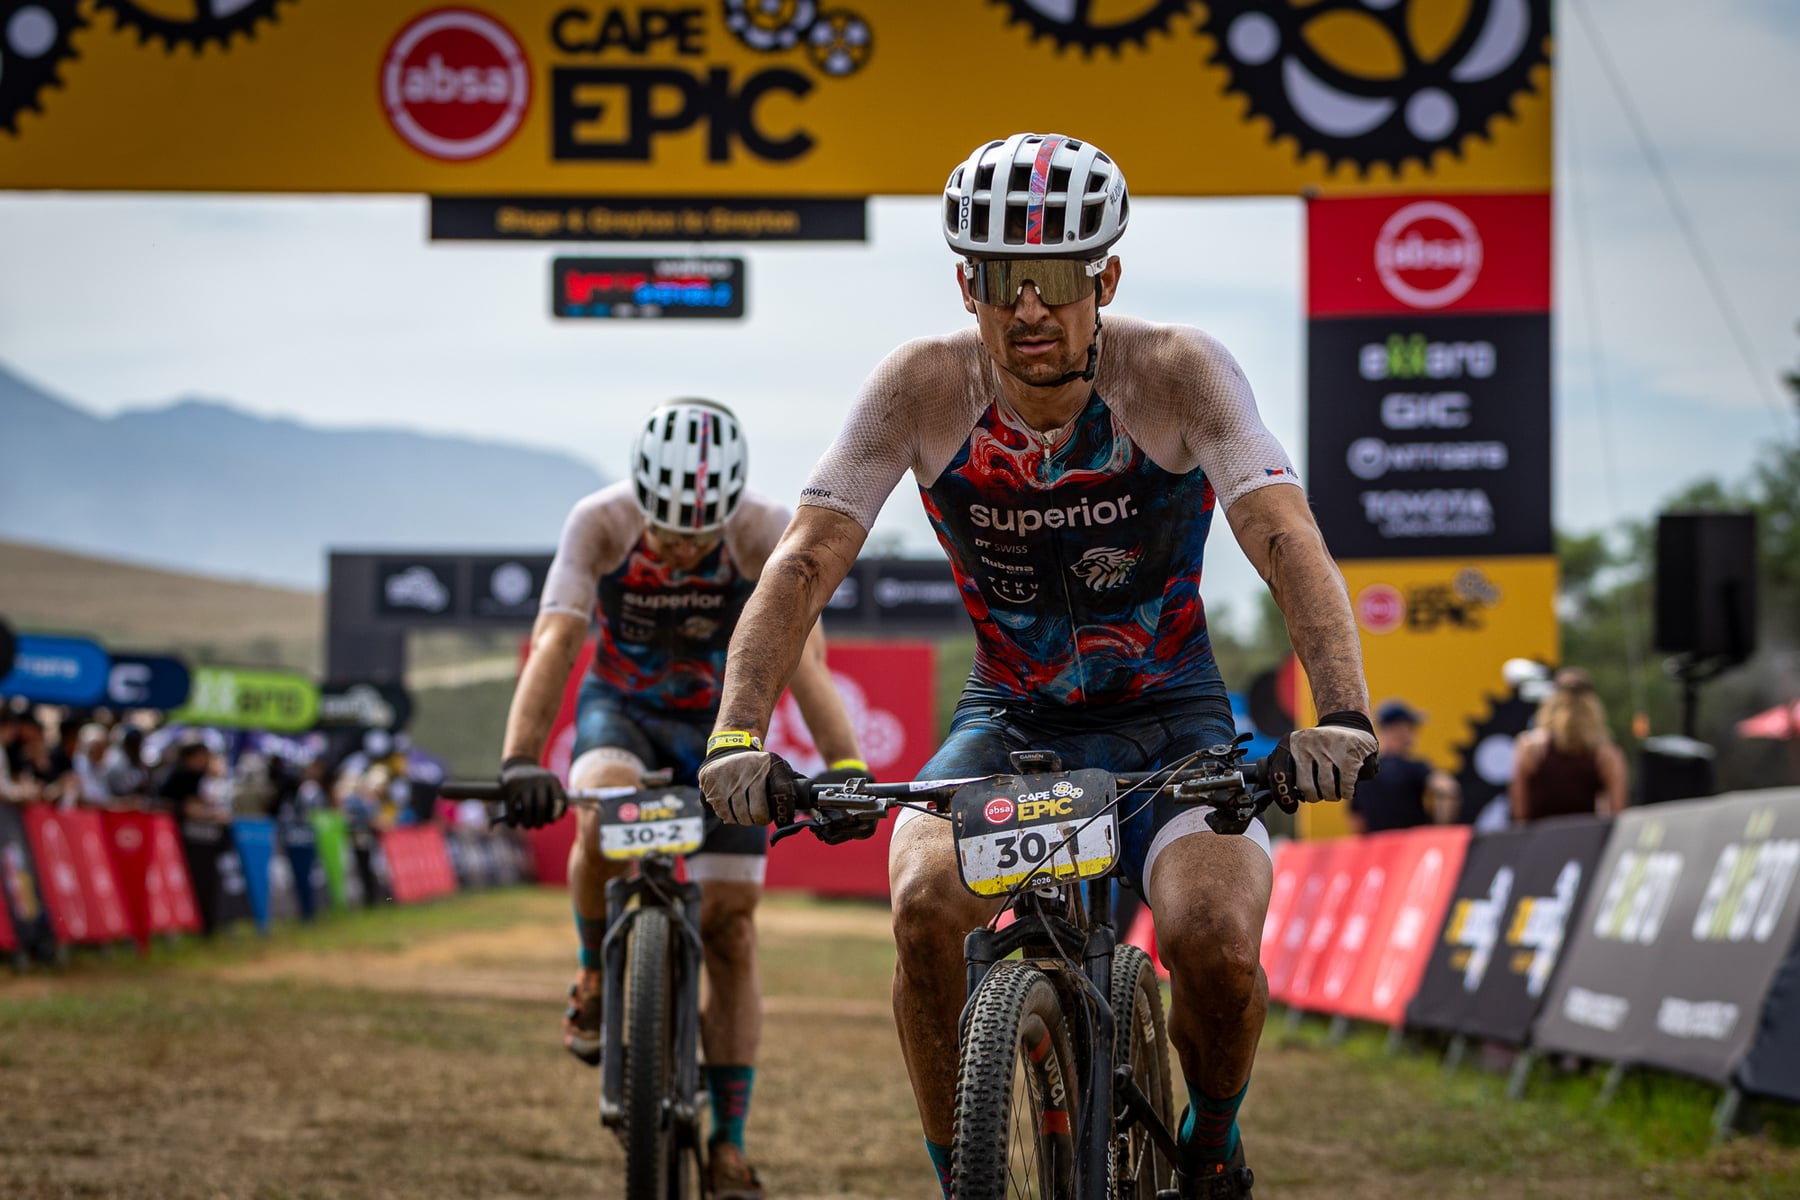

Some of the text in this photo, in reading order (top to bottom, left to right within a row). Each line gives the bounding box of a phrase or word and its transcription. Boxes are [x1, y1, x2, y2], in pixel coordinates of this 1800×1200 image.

[549, 7, 706, 54] CAPE
[402, 54, 509, 102] absa
[550, 66, 818, 161] EPIC
[969, 494, 1138, 537] superior.
[975, 538, 1028, 554] DT SWISS
[980, 555, 1034, 572] Rubena
[1017, 791, 1049, 803] CAPE
[988, 804, 1011, 815] absa
[1017, 797, 1073, 821] EPIC
[623, 824, 682, 845] 30-2
[1031, 877, 1051, 886] 2026
